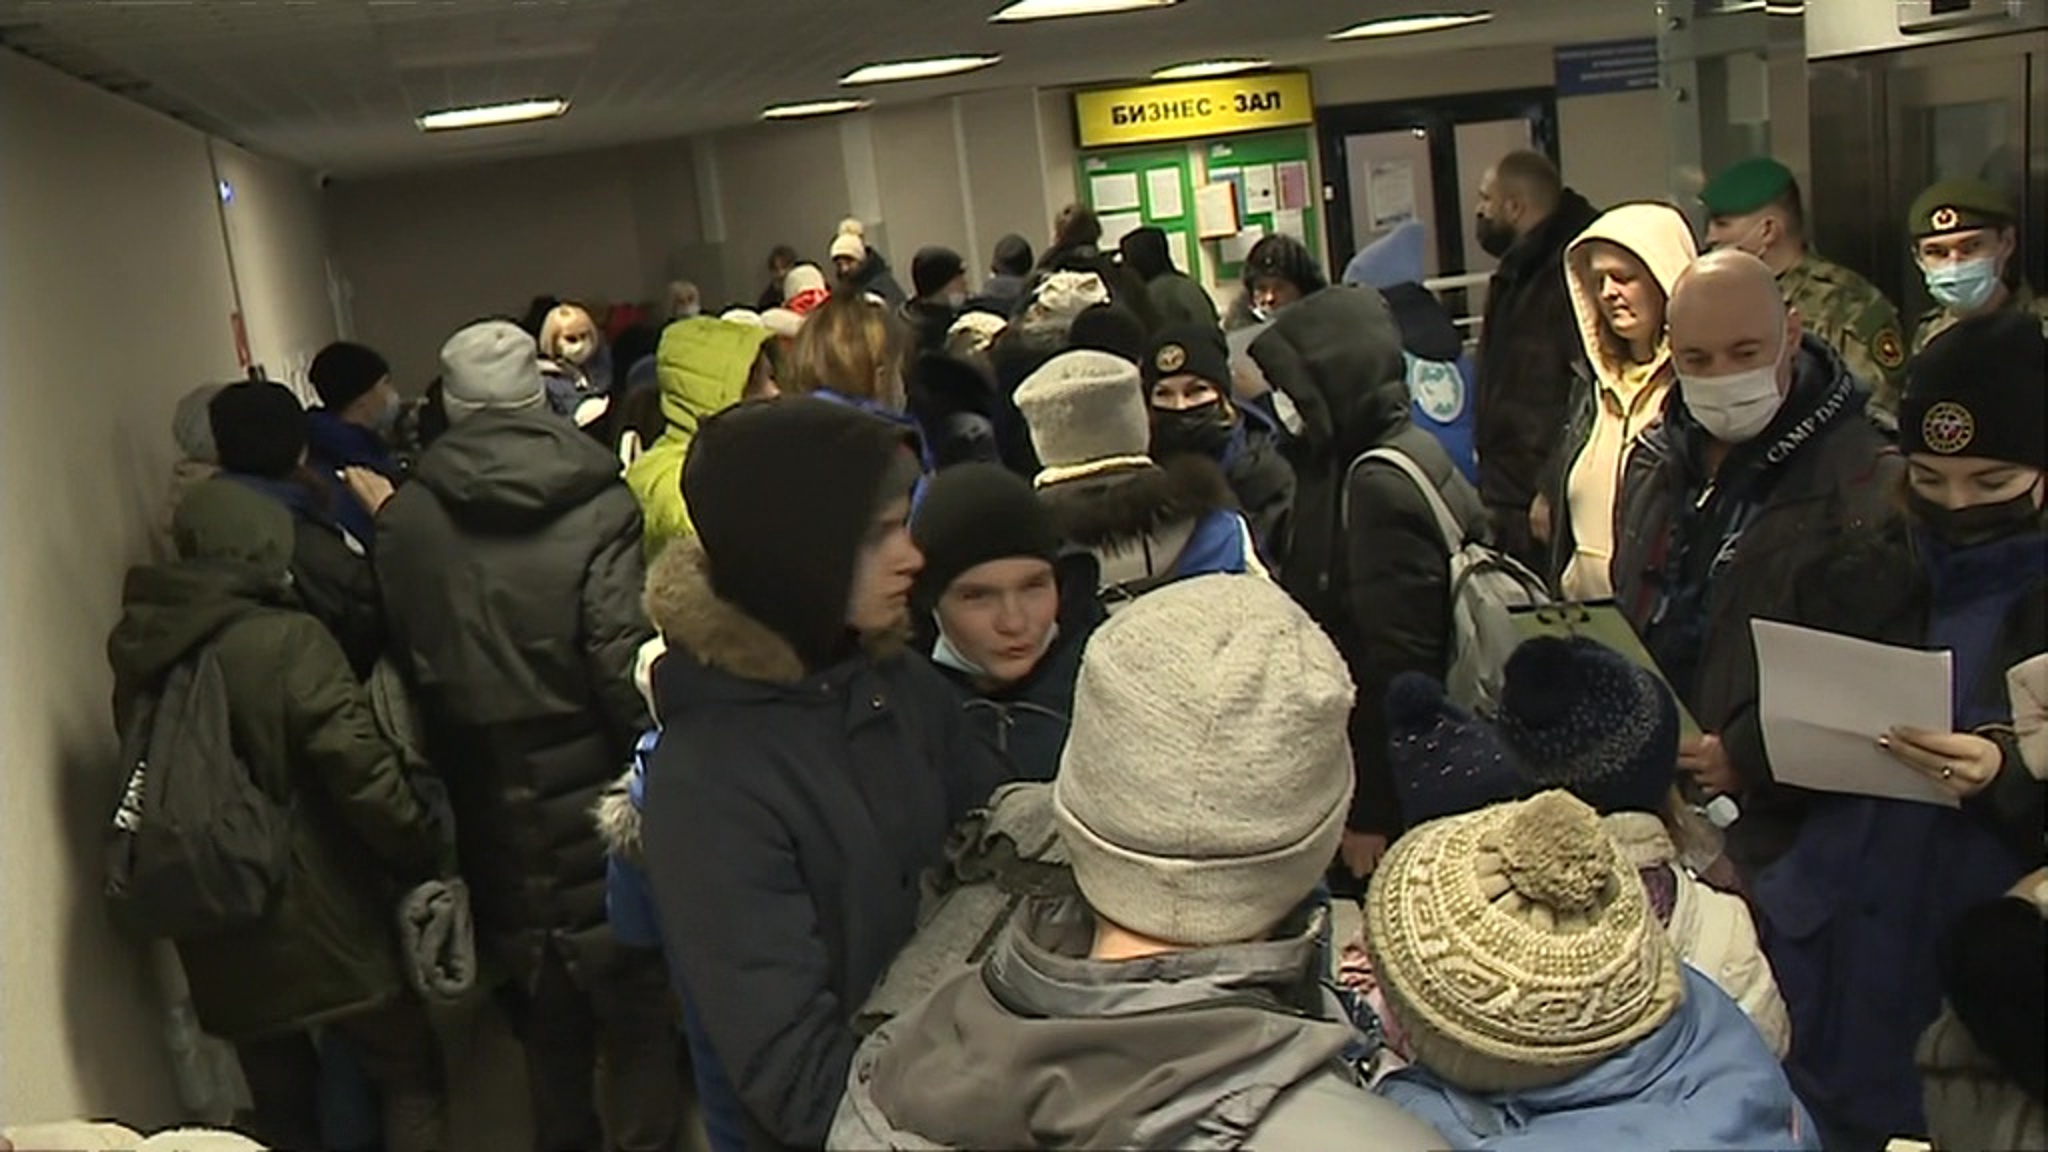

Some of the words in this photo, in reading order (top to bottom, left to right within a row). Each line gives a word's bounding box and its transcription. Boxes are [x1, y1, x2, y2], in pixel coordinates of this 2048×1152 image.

[1111, 98, 1212, 126] БИЗНЕС
[1233, 91, 1282, 114] ЗАЛ
[1767, 417, 1815, 463] CAMP
